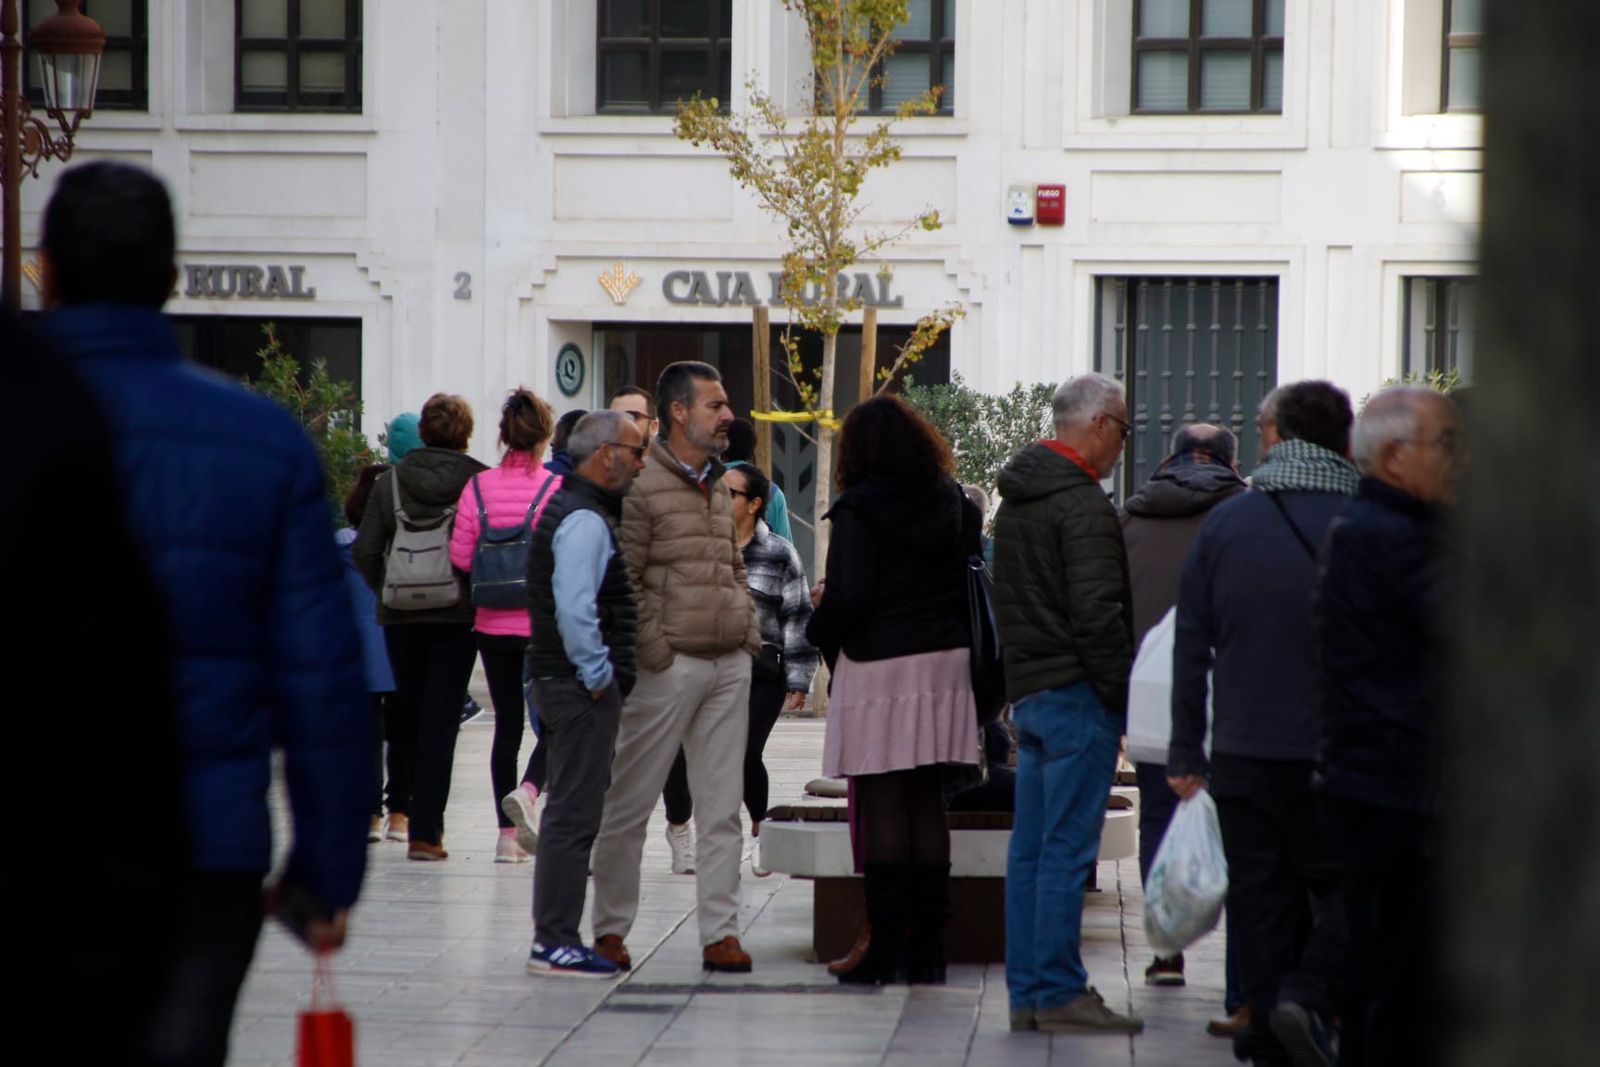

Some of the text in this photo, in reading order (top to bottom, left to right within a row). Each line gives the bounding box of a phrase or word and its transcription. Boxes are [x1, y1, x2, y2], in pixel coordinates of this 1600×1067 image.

[1038, 189, 1060, 198] FUEGO
[184, 264, 316, 298] RURAL
[453, 271, 472, 300] 2
[662, 270, 762, 305] CAJA
